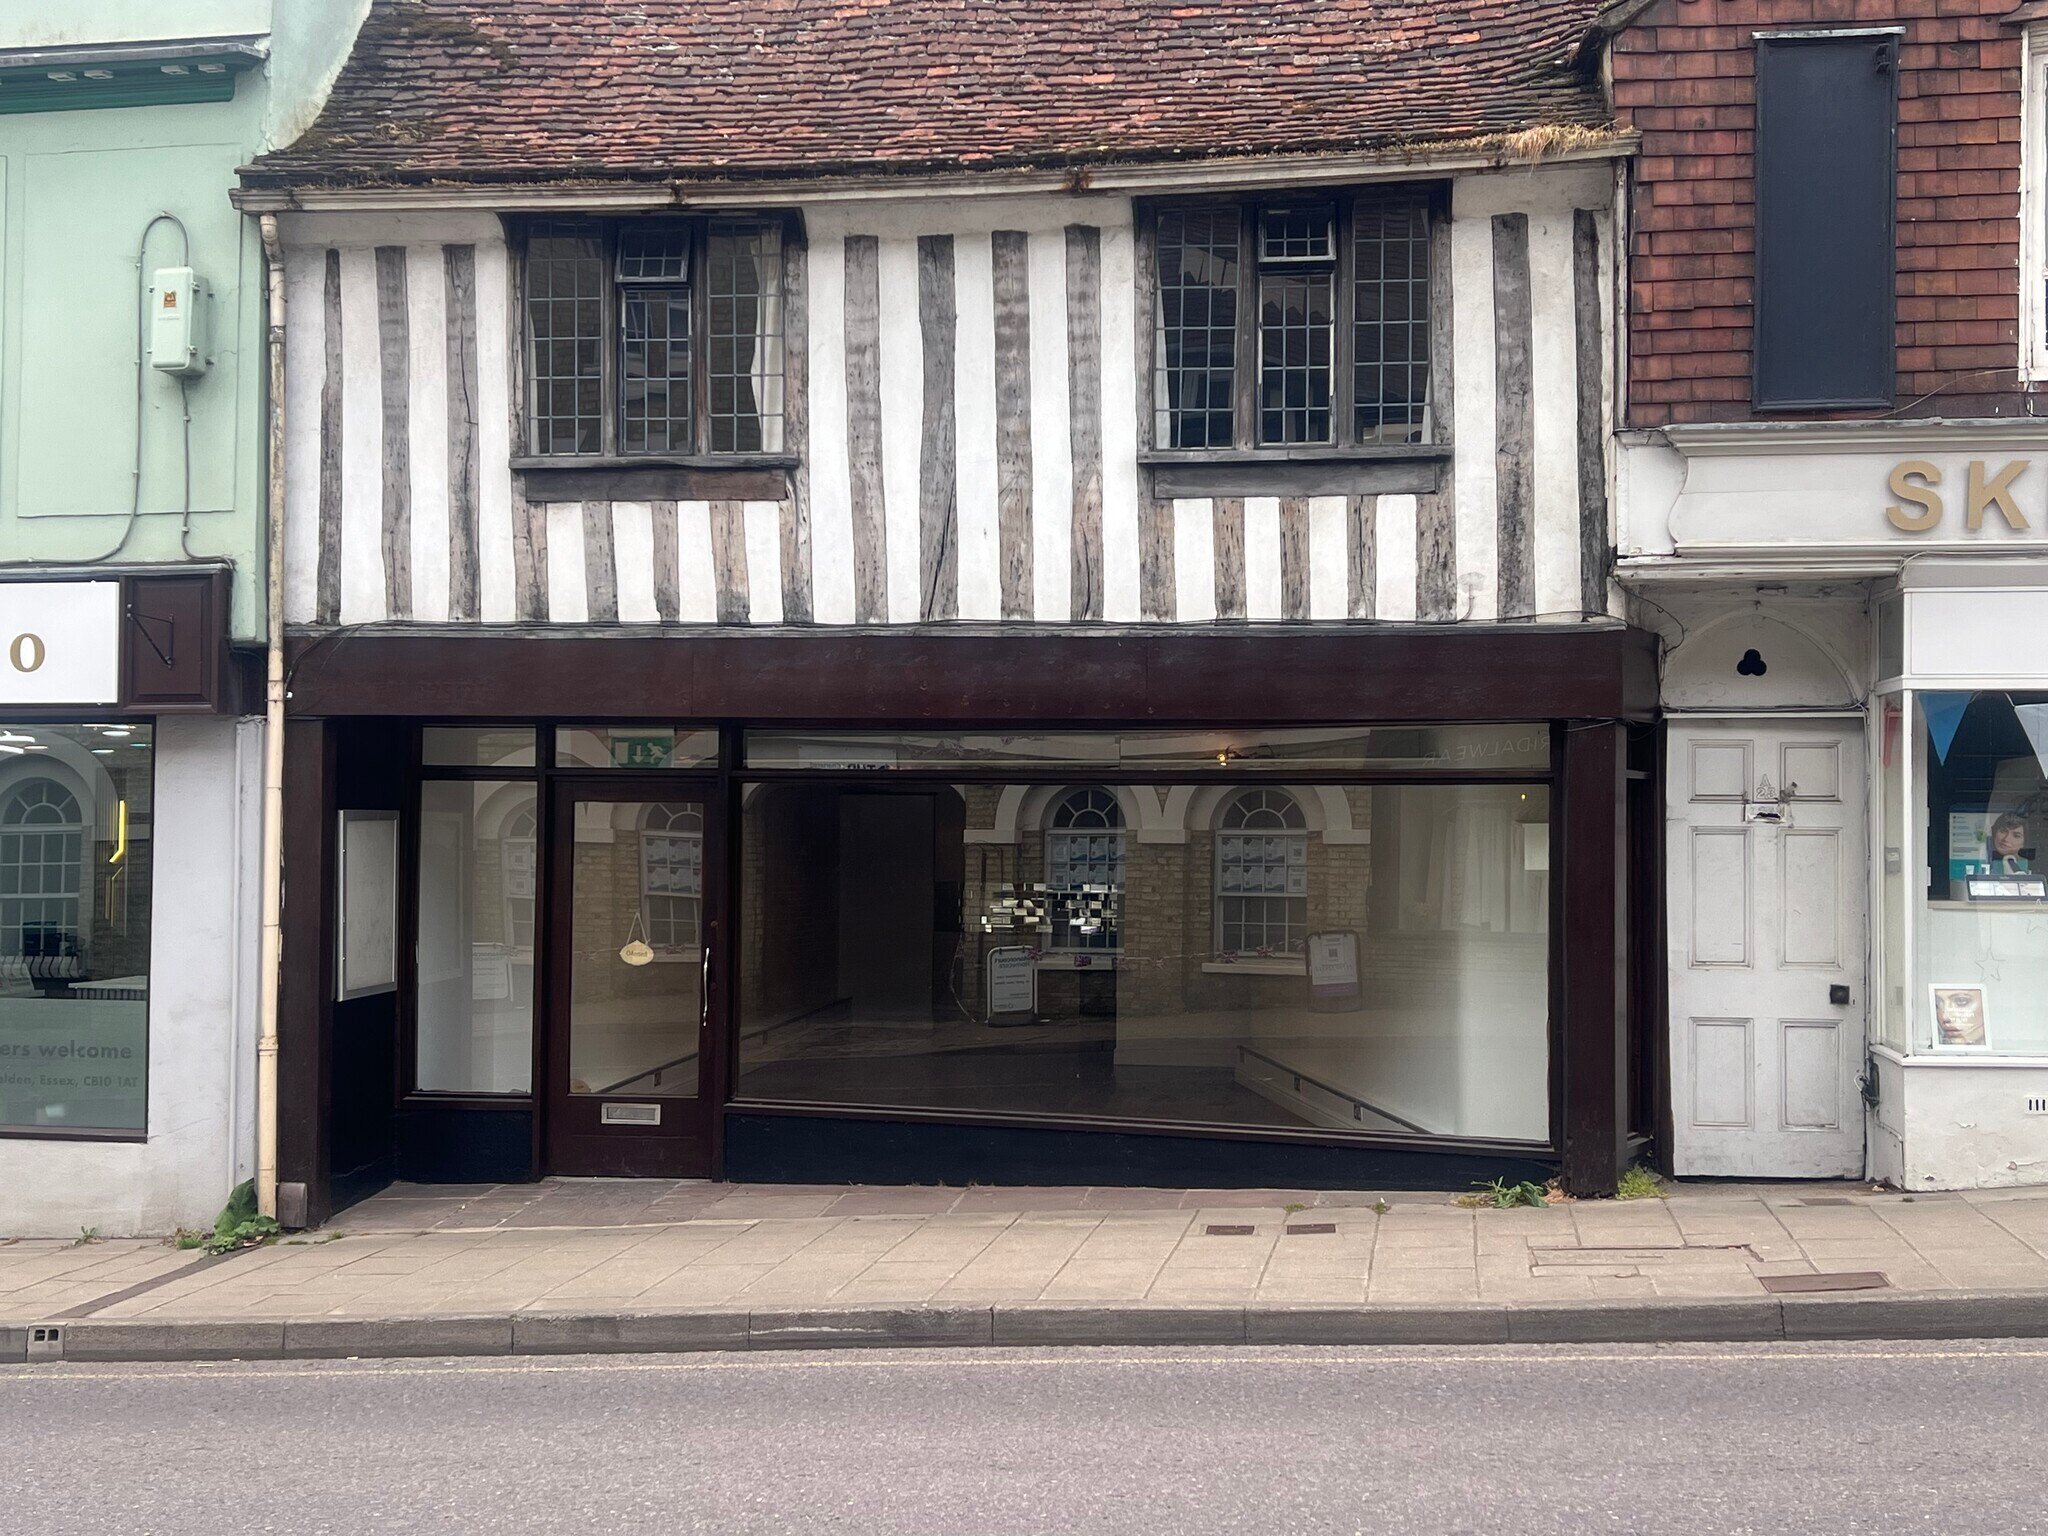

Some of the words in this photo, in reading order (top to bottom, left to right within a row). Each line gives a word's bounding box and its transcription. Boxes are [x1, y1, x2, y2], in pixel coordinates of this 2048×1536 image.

[1886, 459, 2047, 532] SK
[39, 1040, 132, 1059] welcome
[40, 1075, 79, 1088] Essex,
